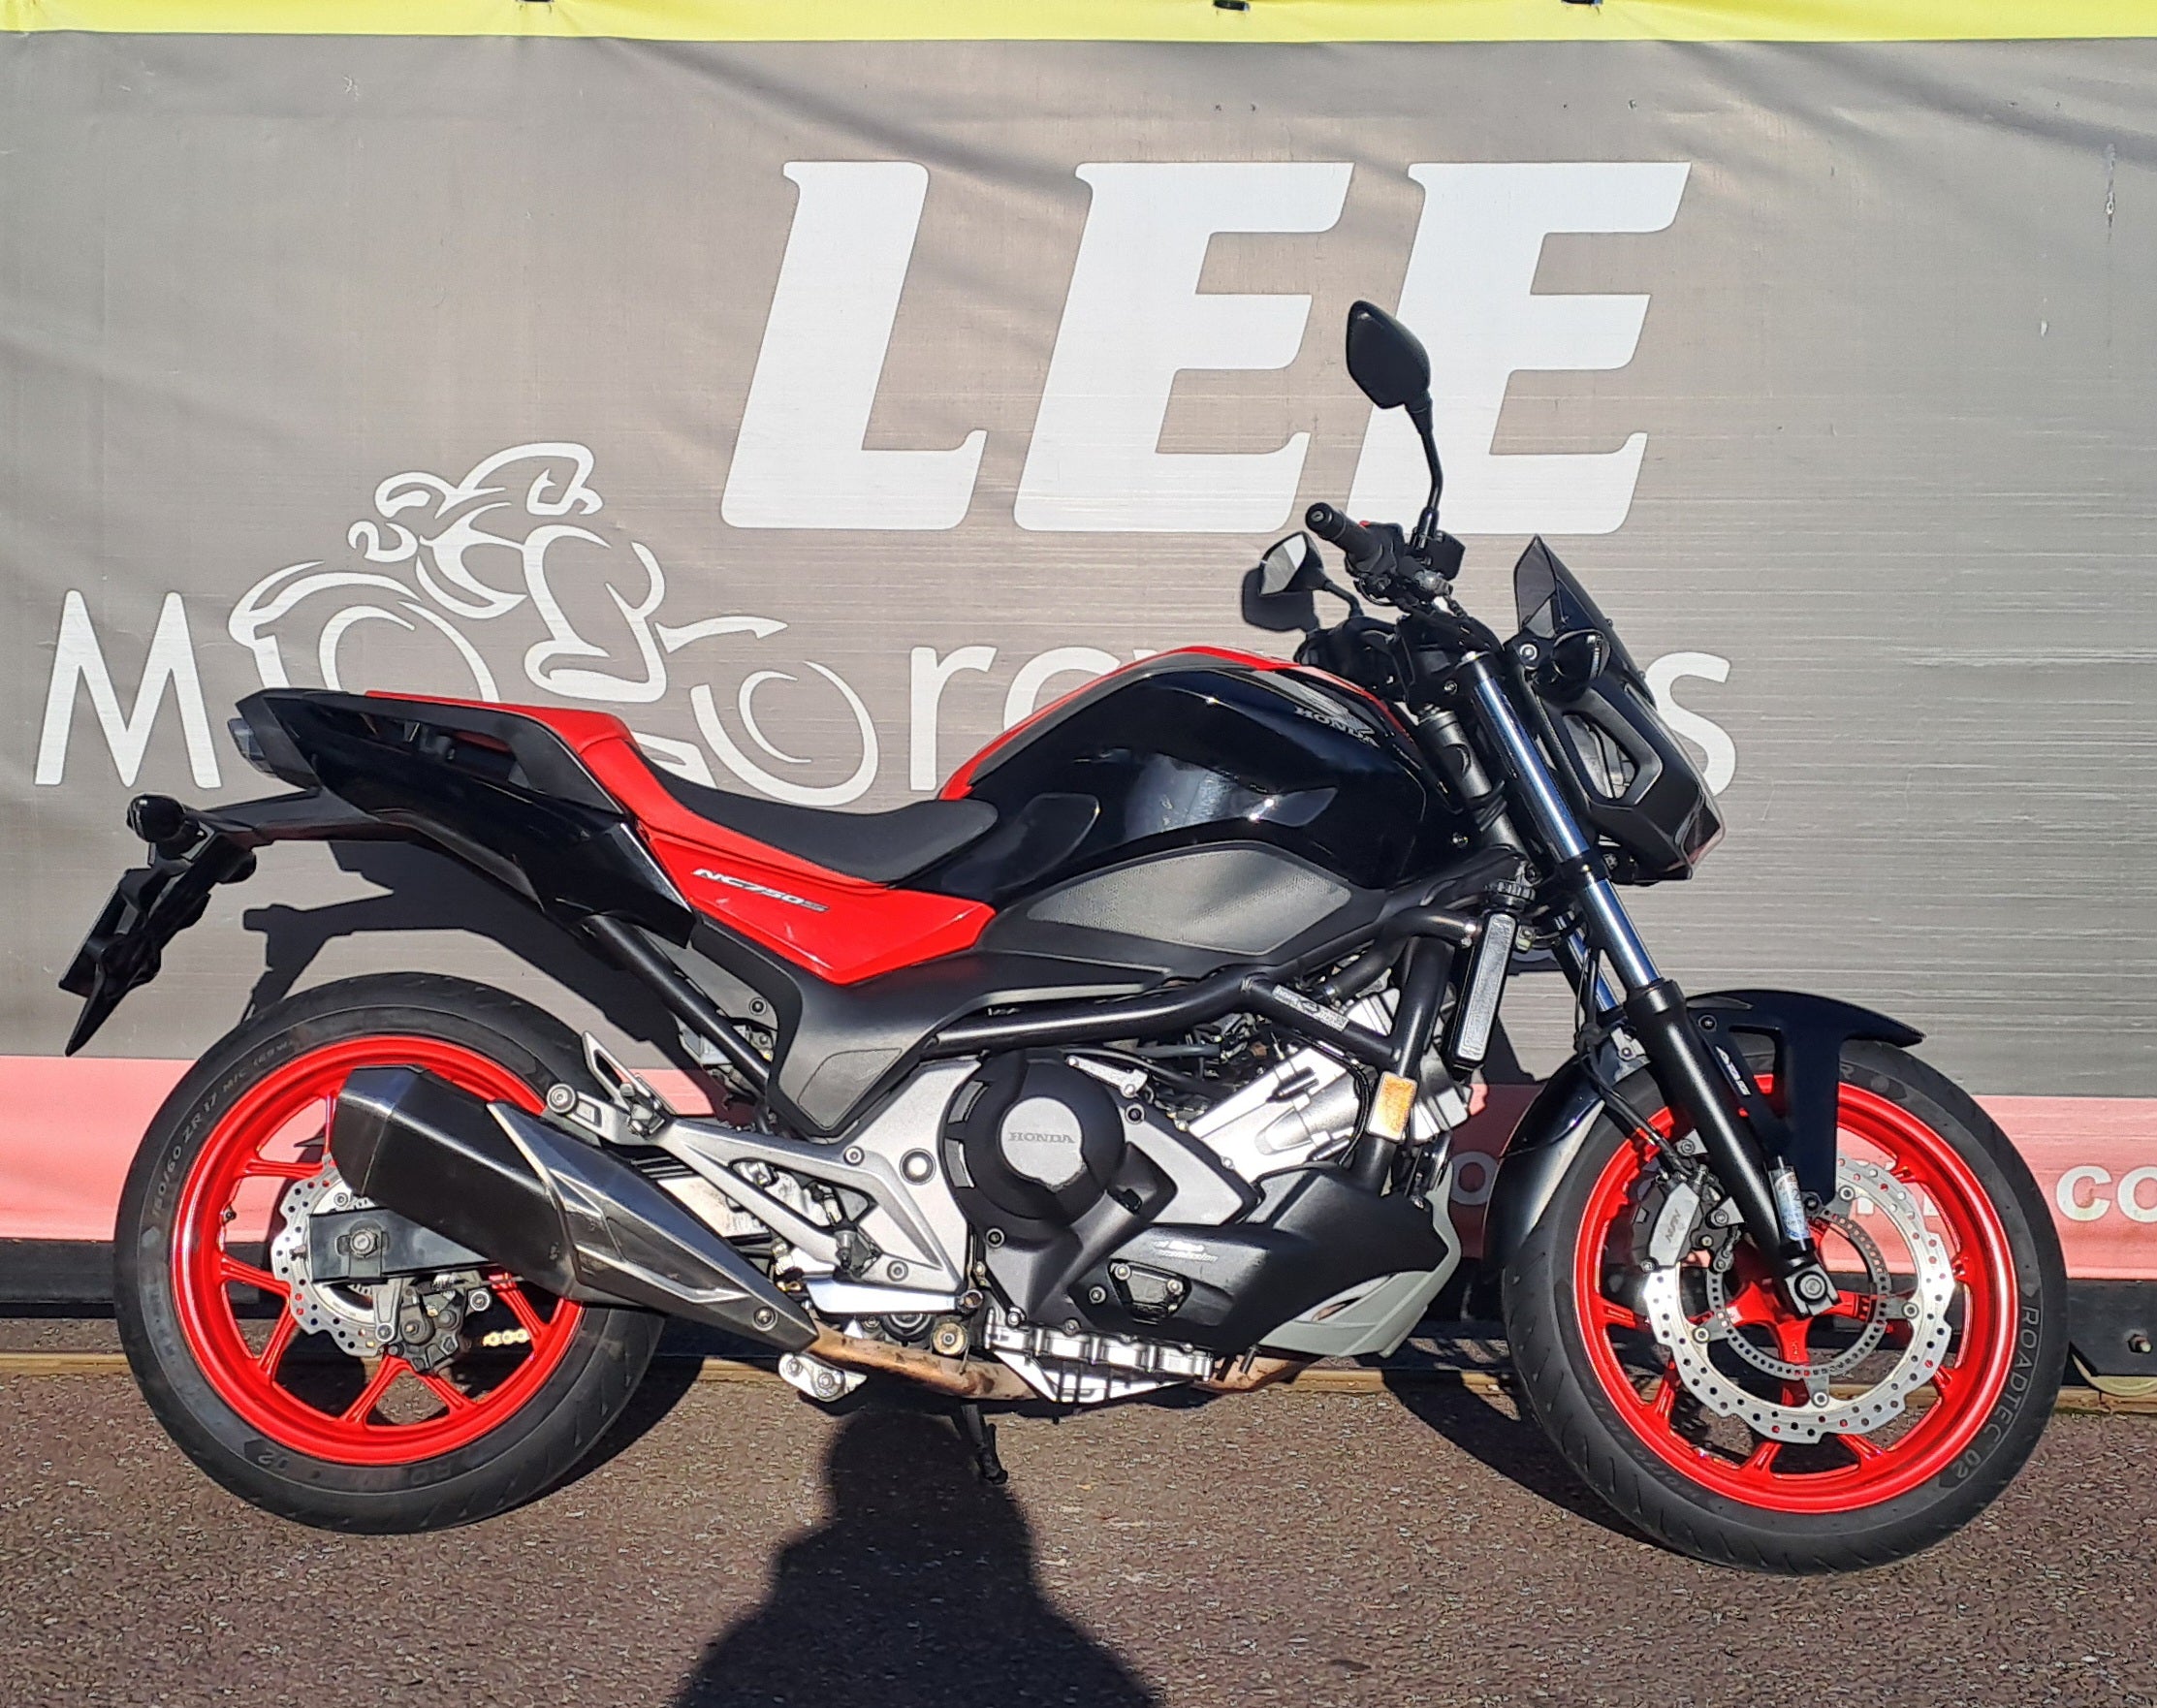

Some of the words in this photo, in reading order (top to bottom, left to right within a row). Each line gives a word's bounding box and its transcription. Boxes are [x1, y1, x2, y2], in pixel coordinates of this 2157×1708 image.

[720, 160, 1692, 535] LEE
[1293, 705, 1380, 748] HONDA
[692, 869, 830, 912] NC750S
[1008, 1131, 1075, 1144] HONDA
[1984, 1308, 2040, 1442] ROADTEC
[1952, 1449, 1982, 1479] 02
